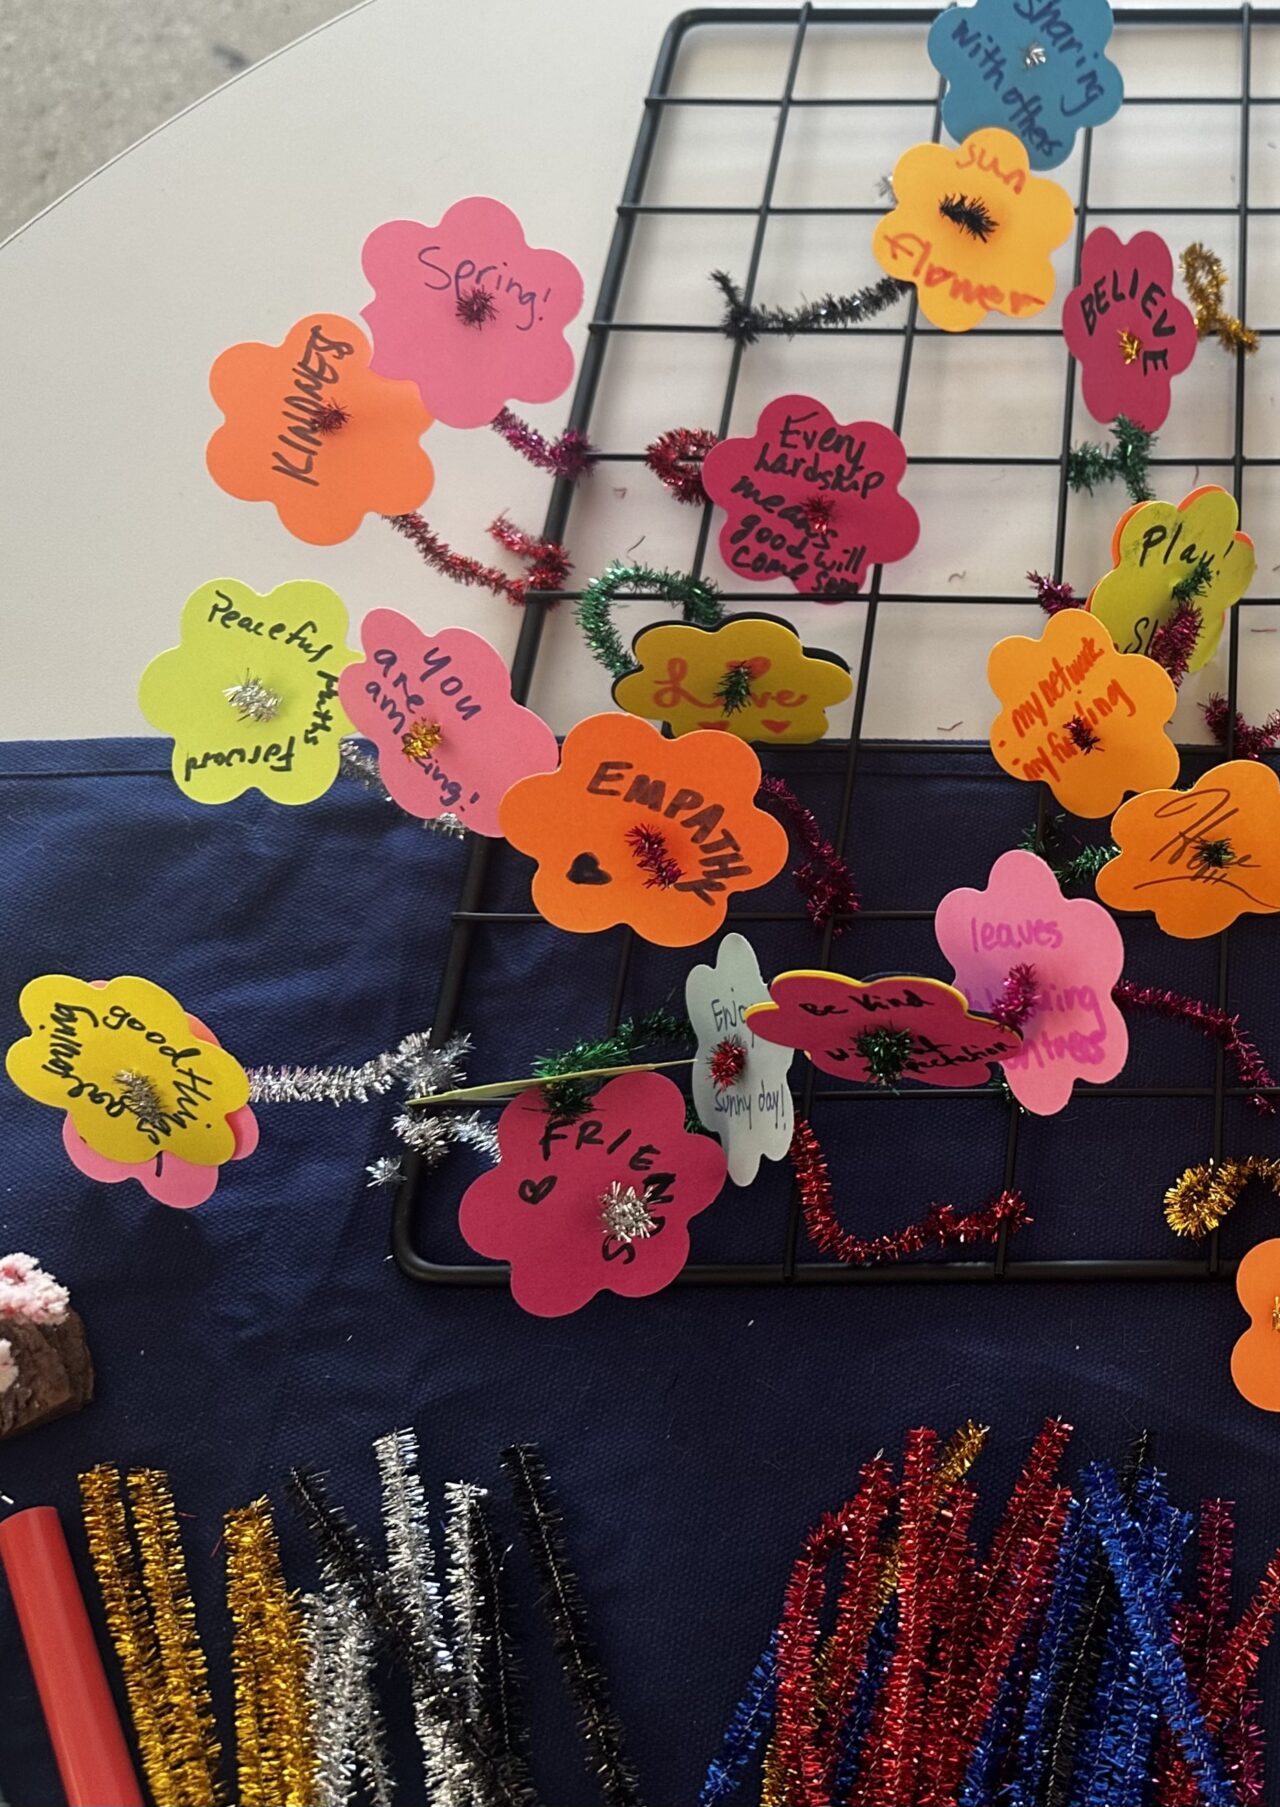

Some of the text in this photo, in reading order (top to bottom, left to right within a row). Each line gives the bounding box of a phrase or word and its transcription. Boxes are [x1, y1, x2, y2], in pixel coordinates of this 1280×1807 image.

[417, 245, 553, 331] Spring!
[1080, 267, 1177, 377] BELIEVE
[779, 411, 867, 471] Every
[1138, 521, 1236, 577] Play!
[207, 589, 333, 664] Peaceful
[652, 656, 809, 709] Lve
[586, 760, 754, 906] EMPATHY
